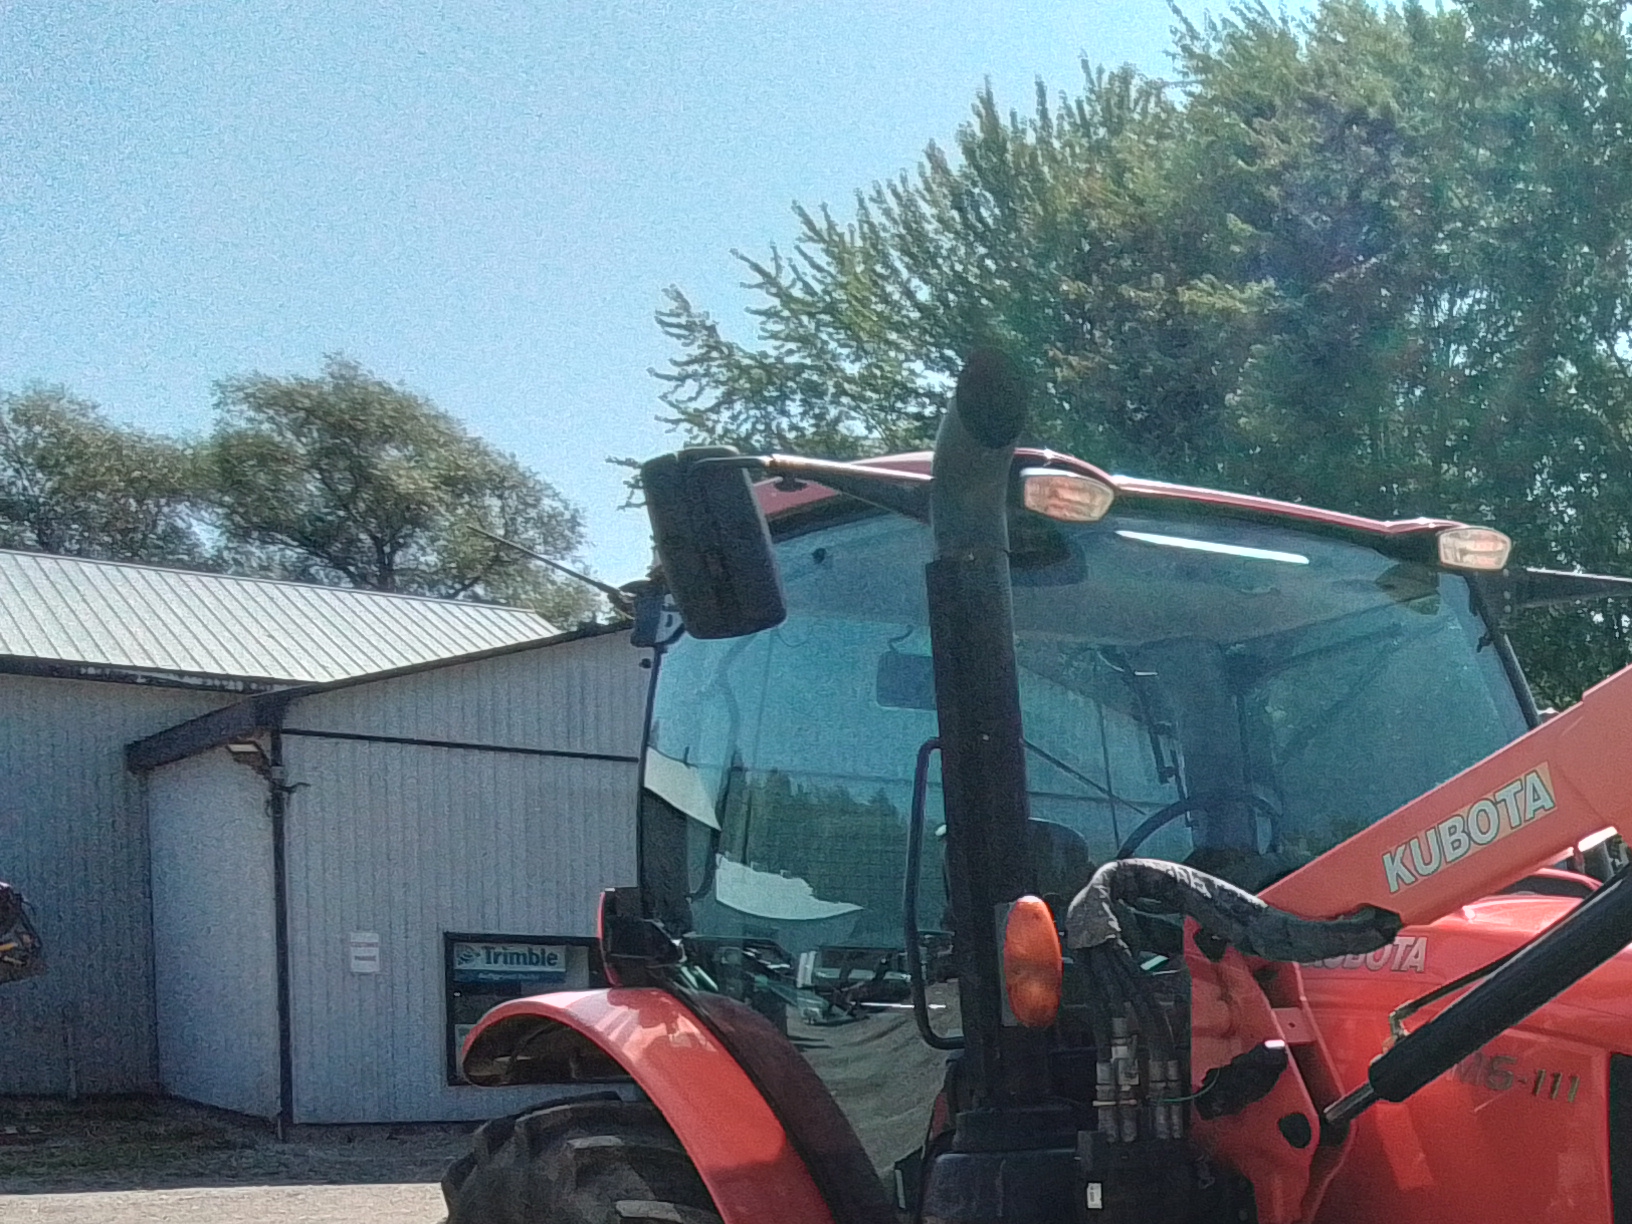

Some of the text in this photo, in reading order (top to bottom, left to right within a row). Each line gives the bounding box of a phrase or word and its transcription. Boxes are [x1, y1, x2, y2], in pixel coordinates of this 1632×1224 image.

[1381, 769, 1556, 893] KUBOTA
[481, 945, 559, 966] Trimble
[1300, 936, 1428, 973] OTA
